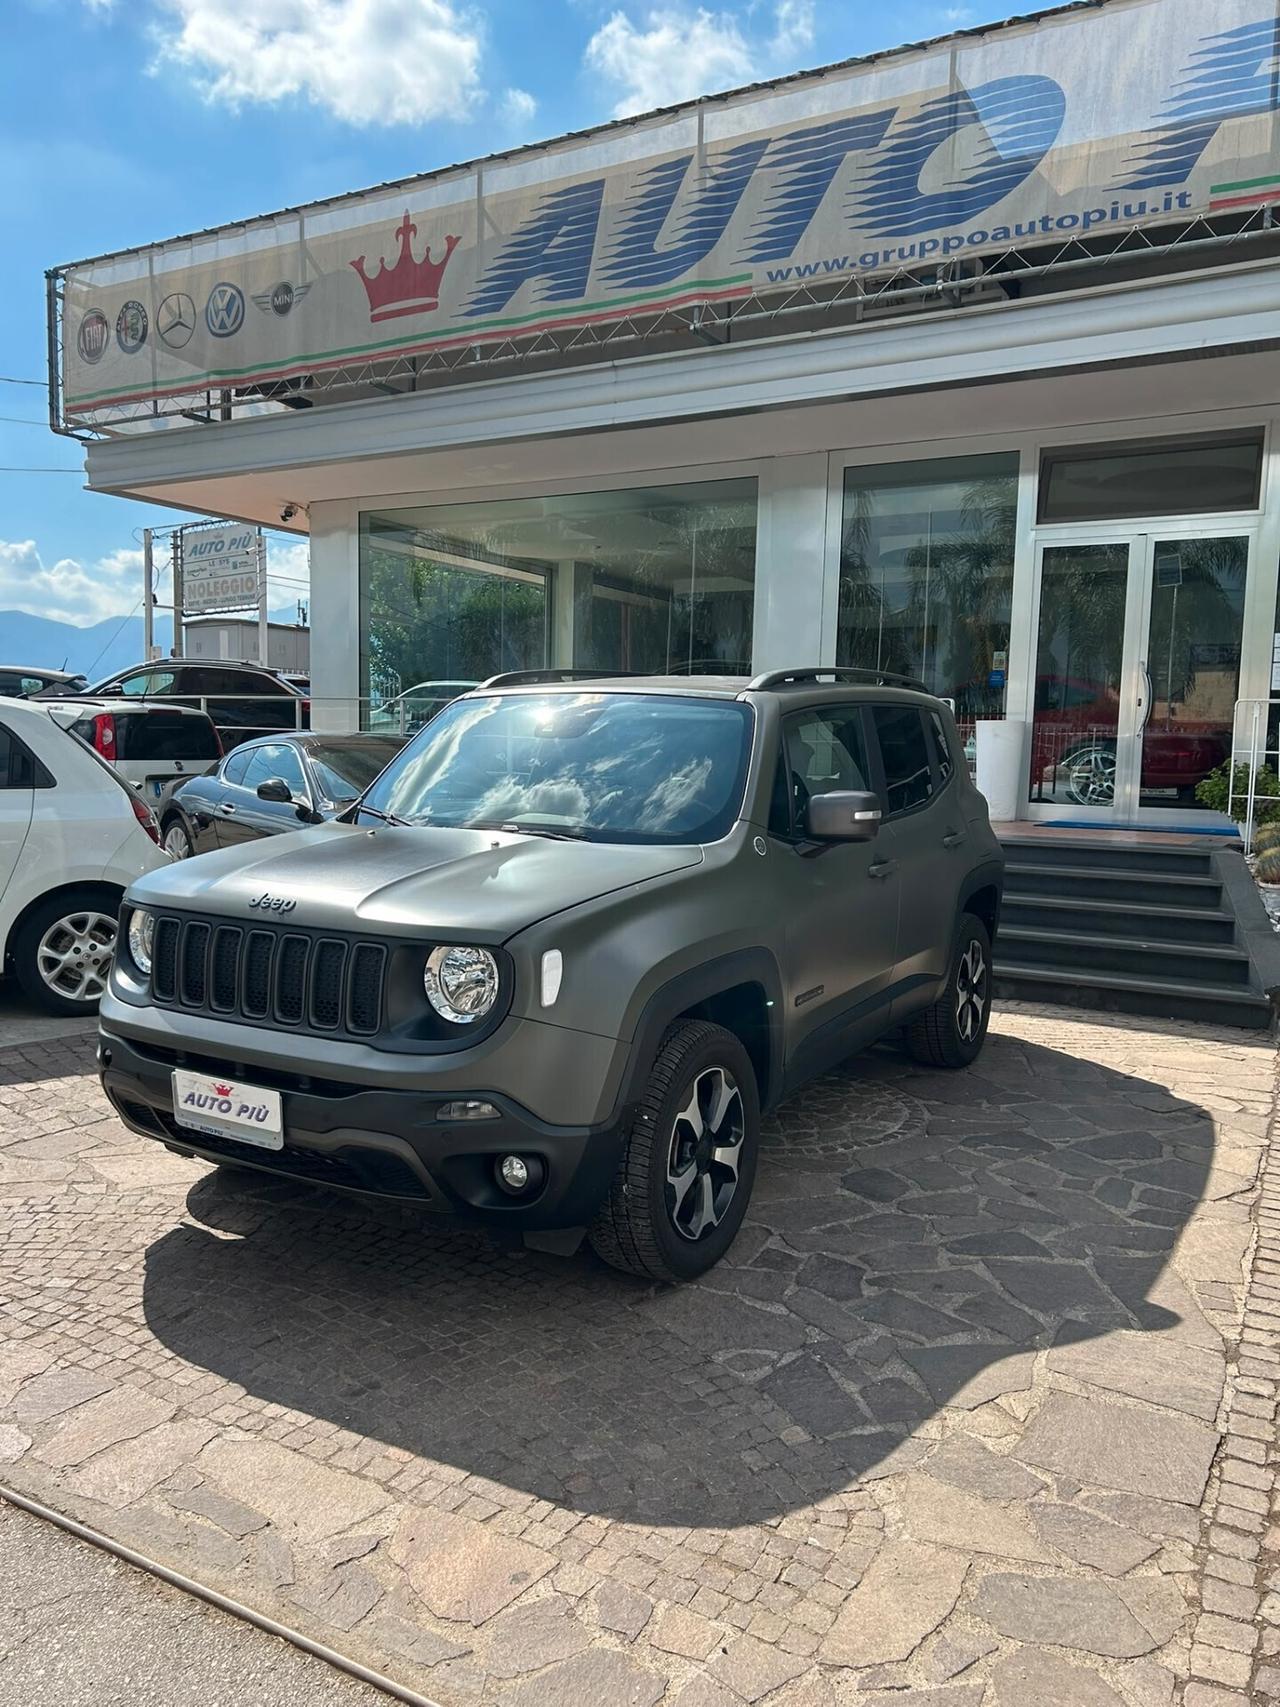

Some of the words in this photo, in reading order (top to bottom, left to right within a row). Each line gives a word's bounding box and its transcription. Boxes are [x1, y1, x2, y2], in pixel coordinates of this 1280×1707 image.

[451, 74, 1066, 318] AUTO
[767, 190, 1192, 283] www.gruppoautopiu.it
[273, 293, 294, 307] MINI
[85, 323, 104, 352] FIAT
[189, 540, 225, 557] AUTO
[228, 531, 252, 551] PIÙ
[188, 576, 255, 599] NOLEGGIO
[248, 893, 297, 915] Jeep
[184, 1091, 232, 1114] AUTO
[236, 1104, 270, 1123] PIÙ
